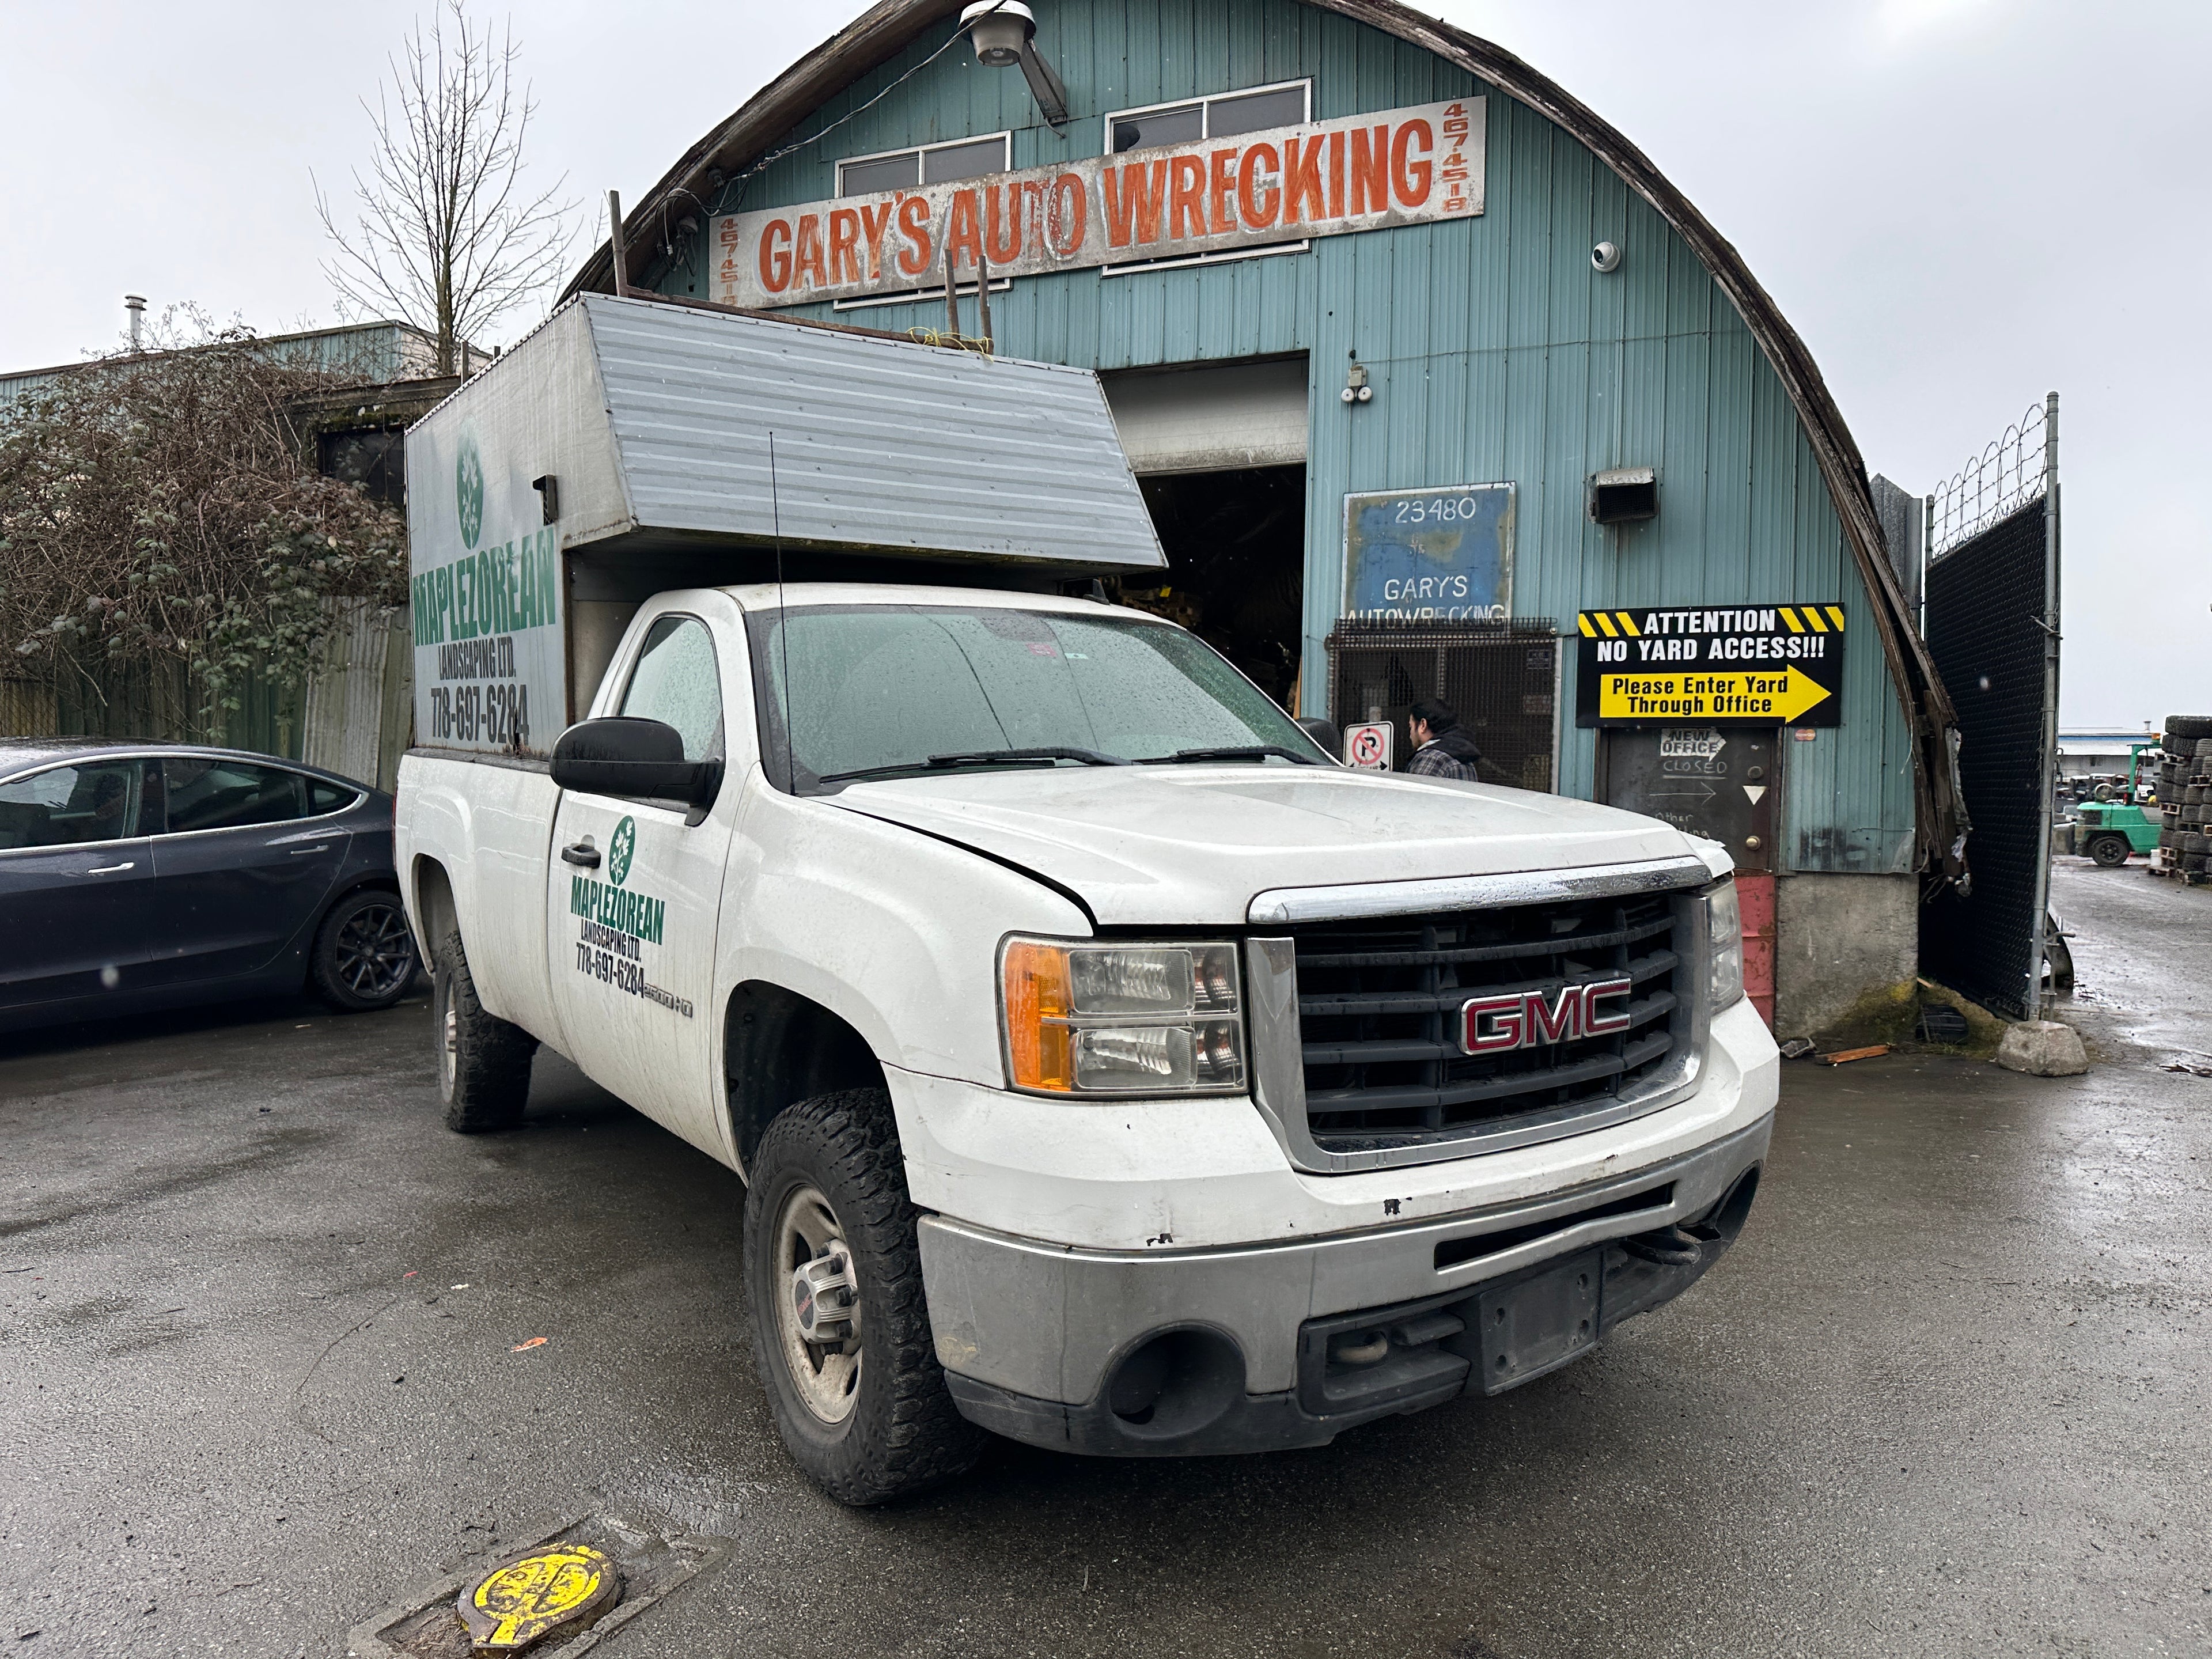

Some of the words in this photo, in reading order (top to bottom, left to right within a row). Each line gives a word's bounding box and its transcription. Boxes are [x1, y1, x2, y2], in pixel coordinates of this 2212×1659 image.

[757, 191, 931, 294] GARY'S
[947, 173, 1087, 270] AUTO
[1103, 118, 1434, 248] WRECKING
[1395, 497, 1476, 524] 23480
[413, 527, 555, 646] MAPLEZOREAN
[1384, 575, 1467, 600] GARY'S
[1643, 609, 1775, 634] ATTENTION
[438, 638, 495, 680] LANDSCAPING
[497, 637, 516, 677] LTD.
[1597, 640, 1627, 662] NO
[1638, 638, 1697, 661] YARD
[1708, 636, 1825, 659] ACCESS!!!
[1613, 677, 1674, 694] Please
[1683, 677, 1735, 694] Enter
[1745, 676, 1788, 693] Yard
[431, 684, 529, 745] 778-697-6284
[1627, 696, 1703, 715] Through
[1713, 696, 1771, 713] Office
[1662, 741, 1718, 753] OFFICE
[1670, 730, 1709, 741] NEW
[1664, 760, 1727, 774] CLOSED
[571, 875, 665, 945] MAPLEZOREAN
[581, 918, 626, 956] LANDSCAPING
[627, 935, 641, 963] LTD.
[576, 942, 644, 998] 778-697-6284
[1461, 978, 1631, 1055] GMC
